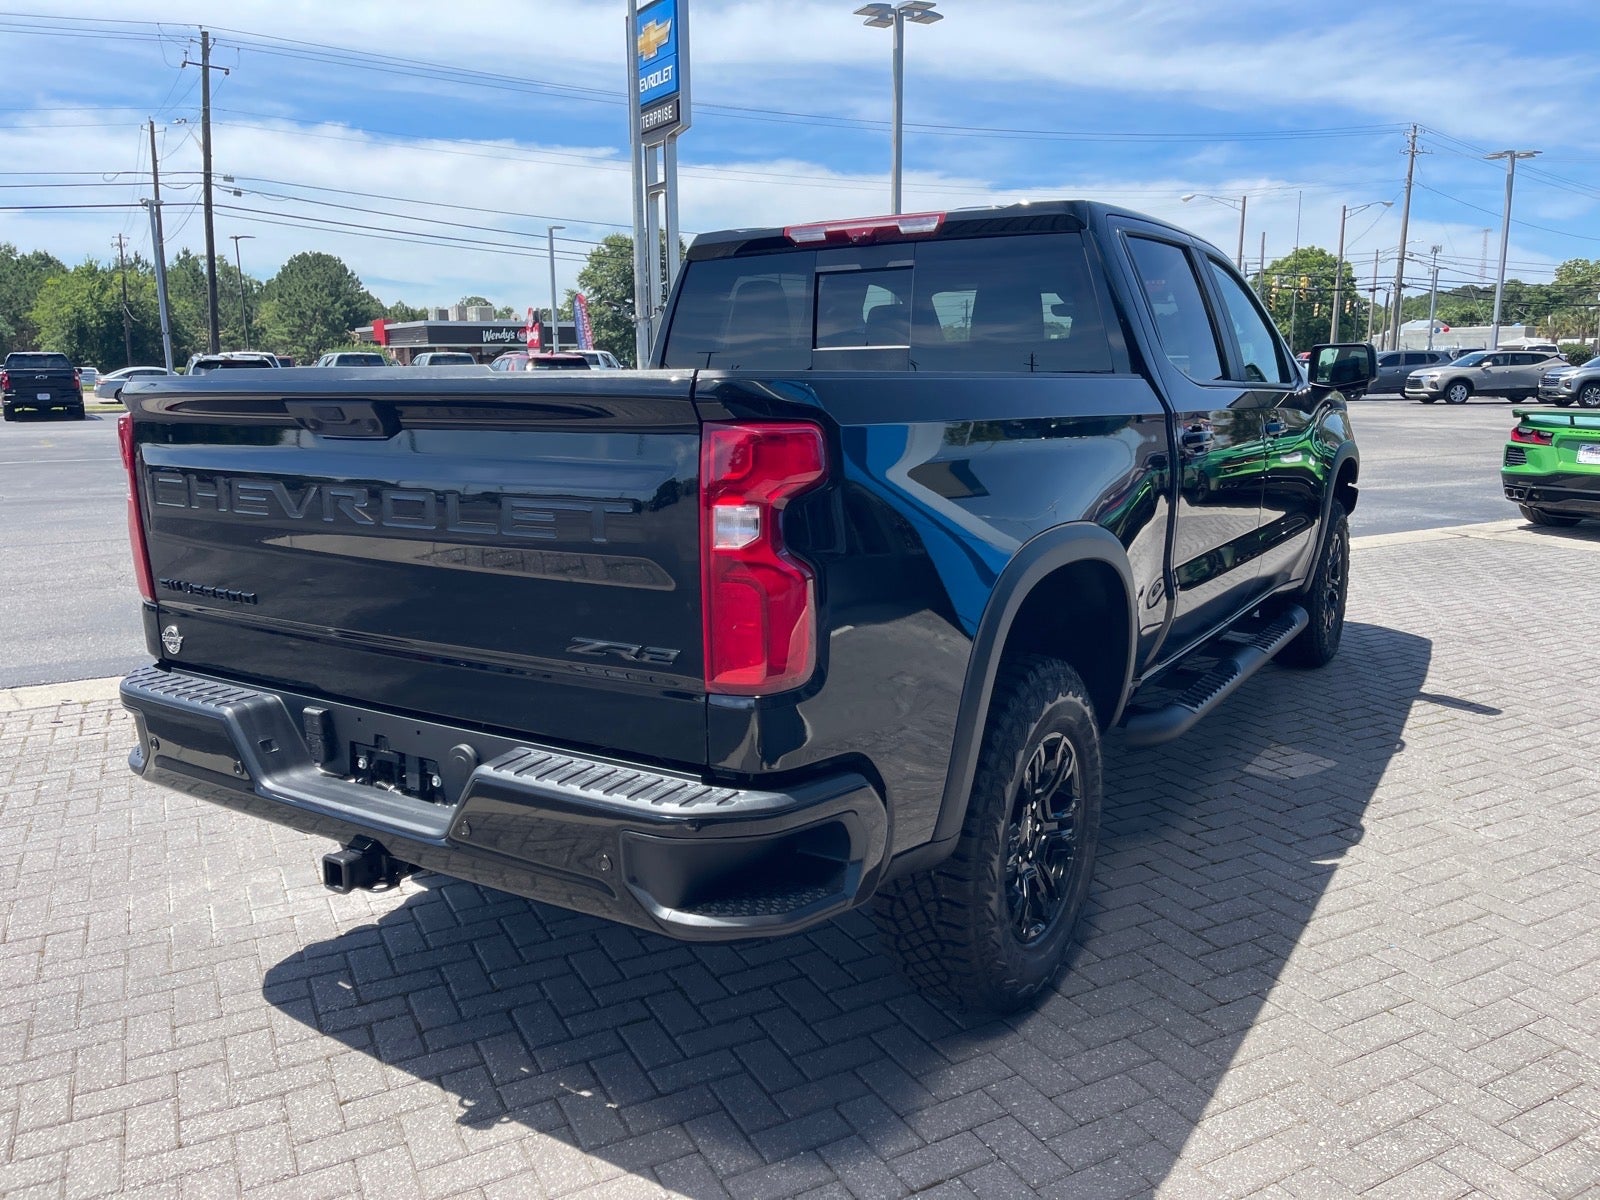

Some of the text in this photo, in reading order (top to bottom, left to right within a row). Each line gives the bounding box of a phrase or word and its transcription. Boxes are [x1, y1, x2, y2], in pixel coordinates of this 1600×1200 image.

[639, 65, 673, 93] EVROLET
[641, 105, 673, 129] TERPRISE
[482, 328, 516, 342] Wendy's
[152, 472, 636, 543] CHEVROLET
